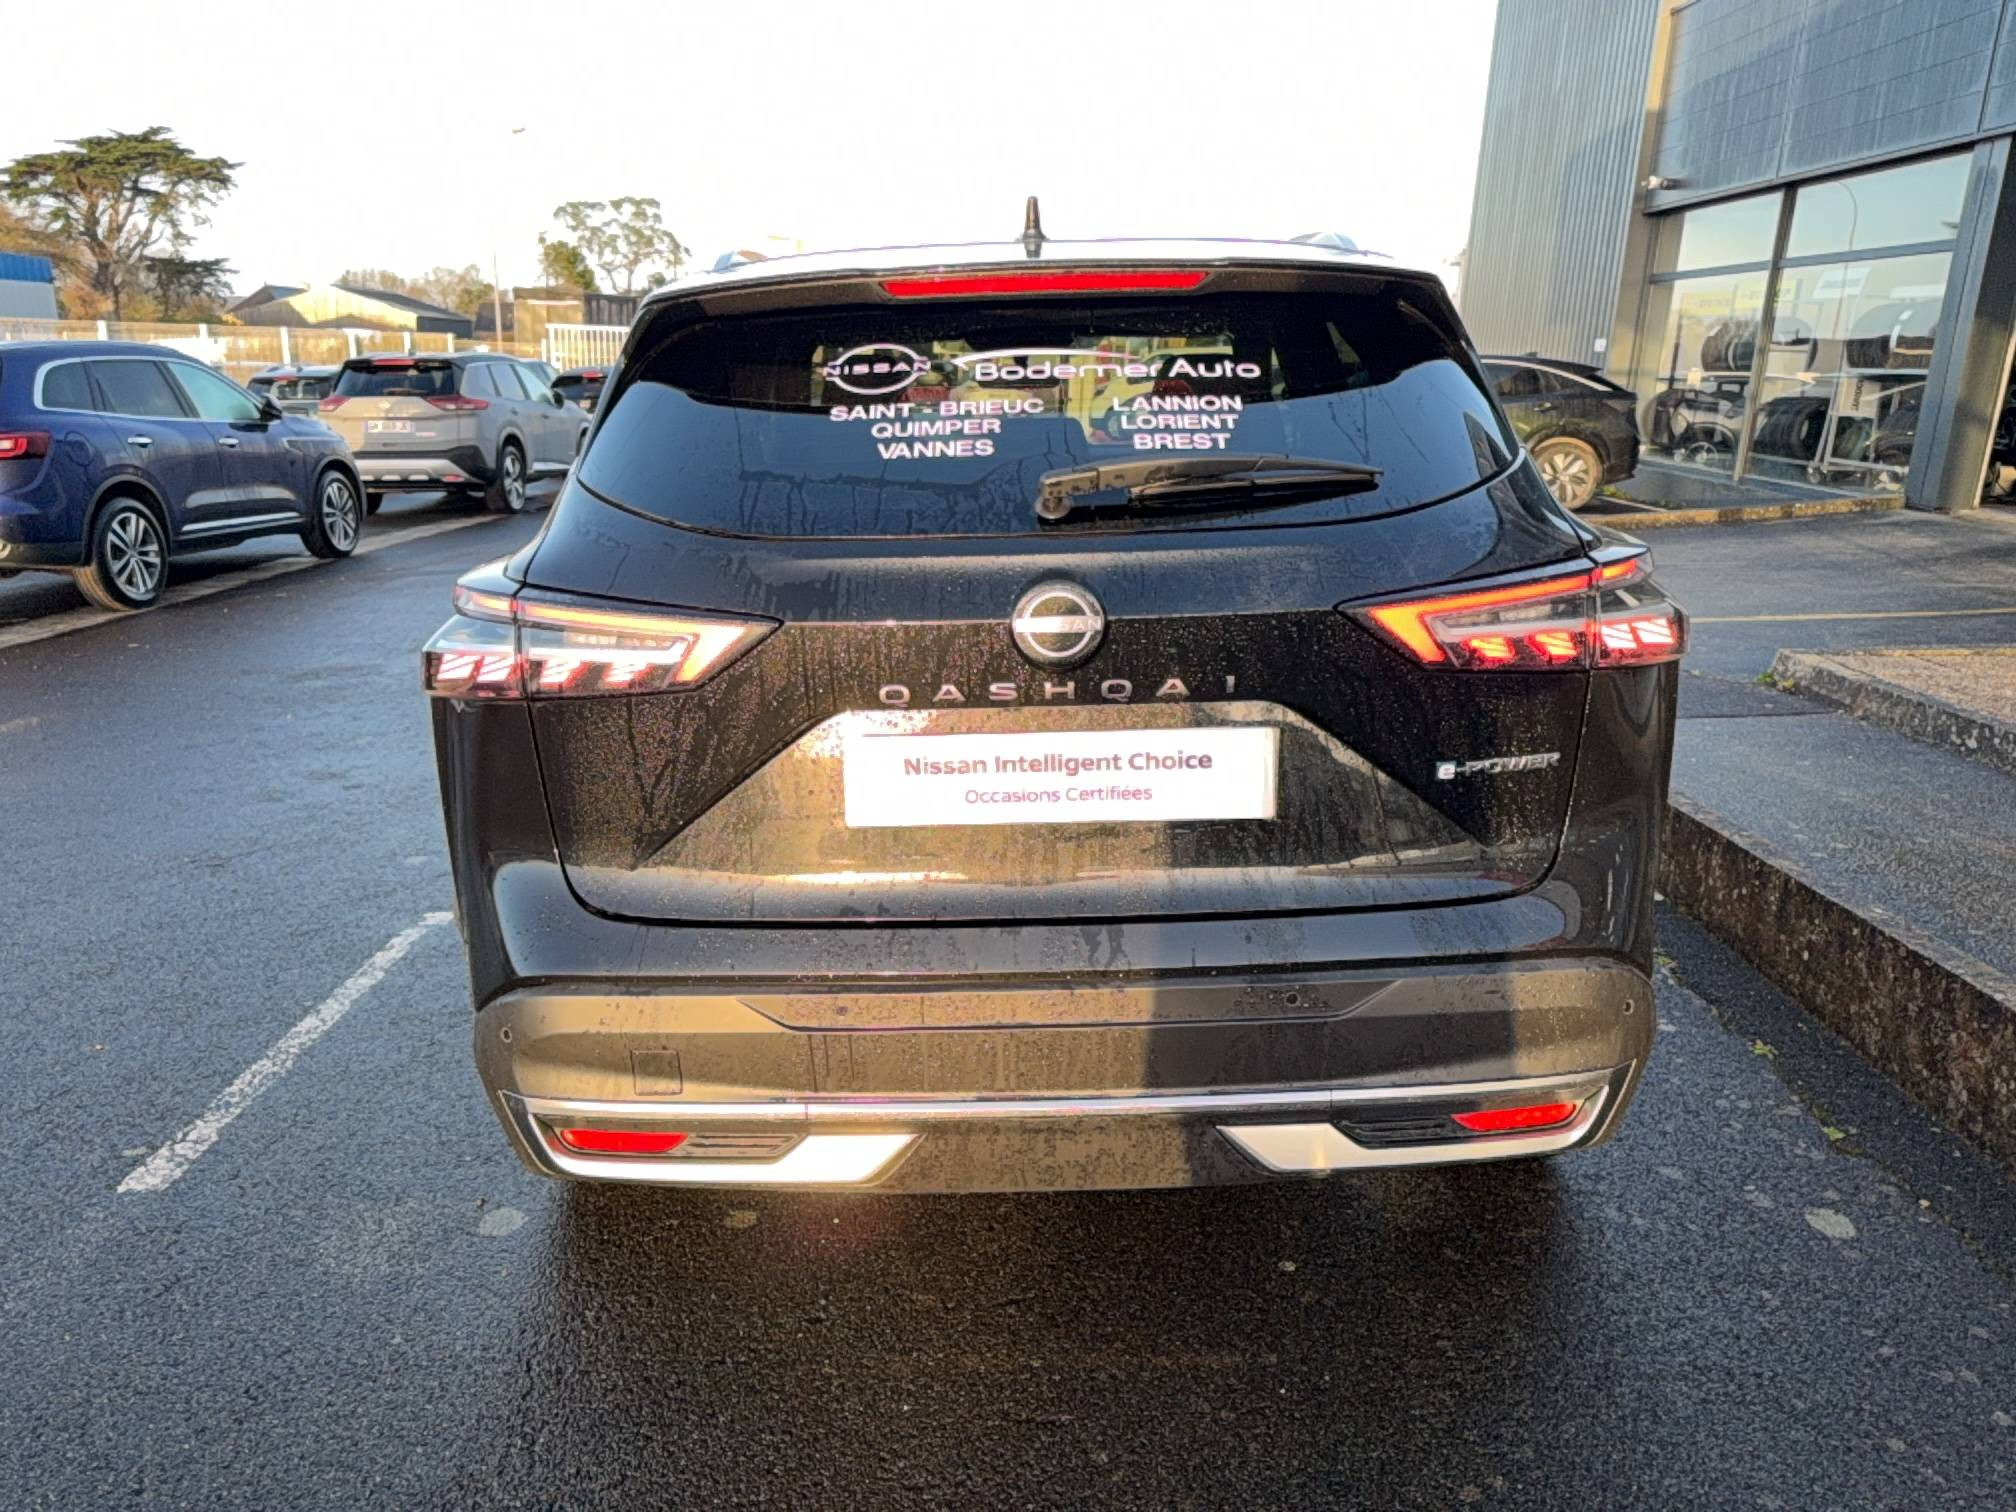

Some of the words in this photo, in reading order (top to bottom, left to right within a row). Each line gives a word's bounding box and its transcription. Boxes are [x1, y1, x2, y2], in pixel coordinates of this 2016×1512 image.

[822, 358, 931, 378] NISSAN
[975, 361, 1162, 381] Bodemer
[1168, 357, 1262, 379] Auto
[1112, 395, 1244, 412] LANNION
[871, 418, 1001, 438] QUIMPER
[1120, 413, 1239, 431] LORIENT
[877, 439, 995, 459] VANNES
[1133, 432, 1231, 450] BREST
[878, 674, 1236, 708] QASHQAI
[904, 756, 987, 776] Nissan
[994, 752, 1122, 777] Intelligent
[1128, 750, 1213, 771] Choice
[965, 788, 1061, 804] Occasions
[1065, 785, 1153, 801] Certifiées
